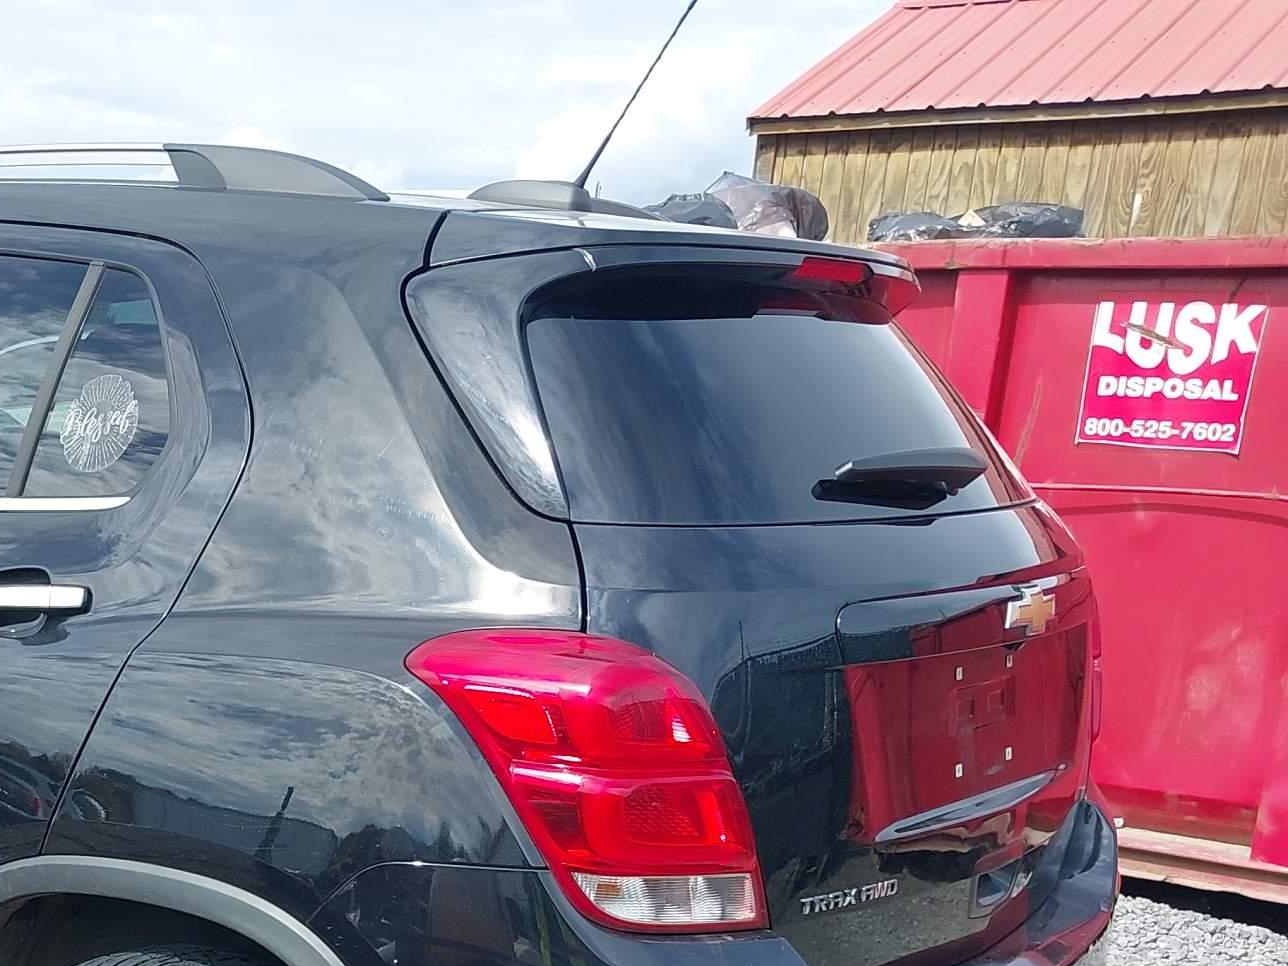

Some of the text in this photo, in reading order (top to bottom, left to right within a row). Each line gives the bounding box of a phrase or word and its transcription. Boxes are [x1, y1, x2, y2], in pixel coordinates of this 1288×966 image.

[1093, 301, 1267, 375] LUSK
[1097, 376, 1239, 401] DISPOSAL
[1084, 418, 1235, 442] 800-525-7602
[800, 879, 898, 915] TRAX AWD
